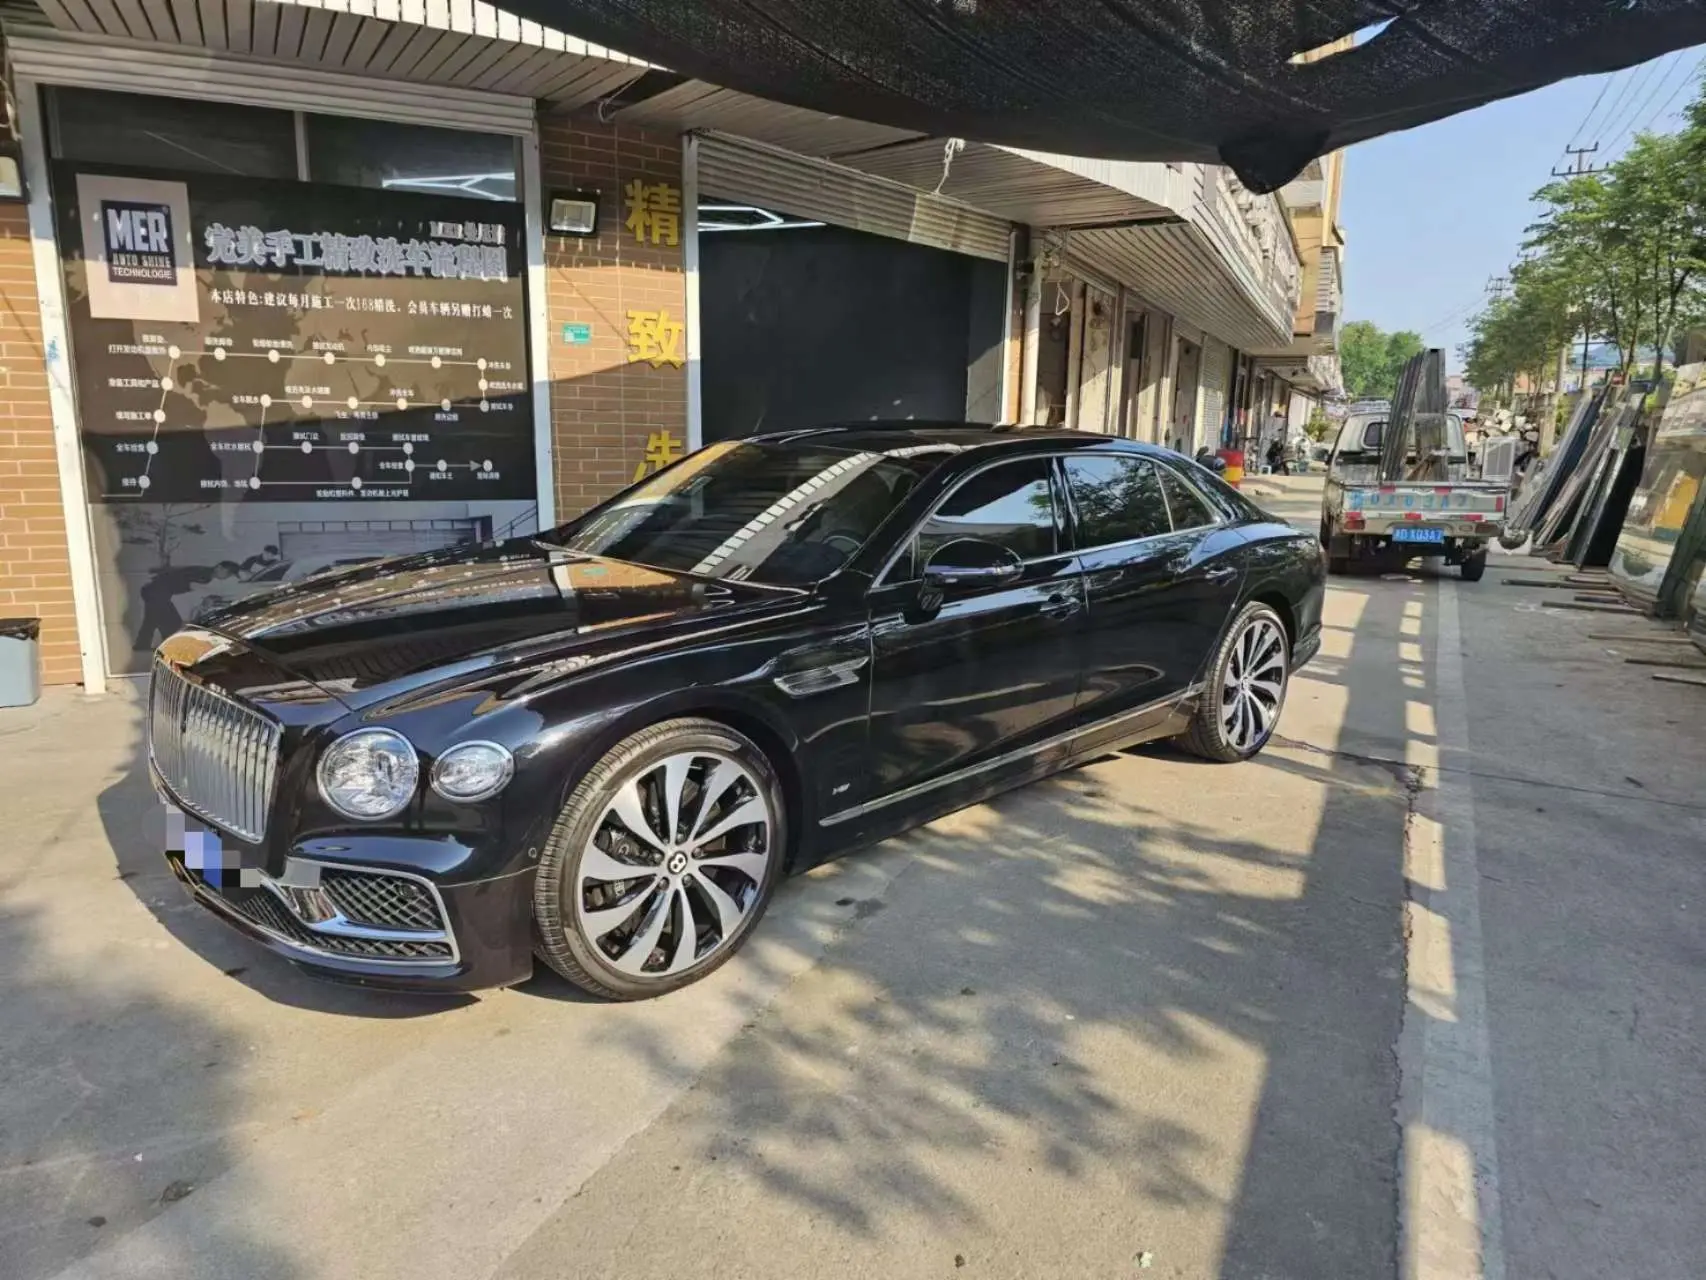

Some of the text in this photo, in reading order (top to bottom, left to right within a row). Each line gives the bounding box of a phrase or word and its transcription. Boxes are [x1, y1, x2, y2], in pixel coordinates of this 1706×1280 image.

[106, 208, 170, 252] MER
[204, 222, 507, 281] 完美手工精致洗车流程图
